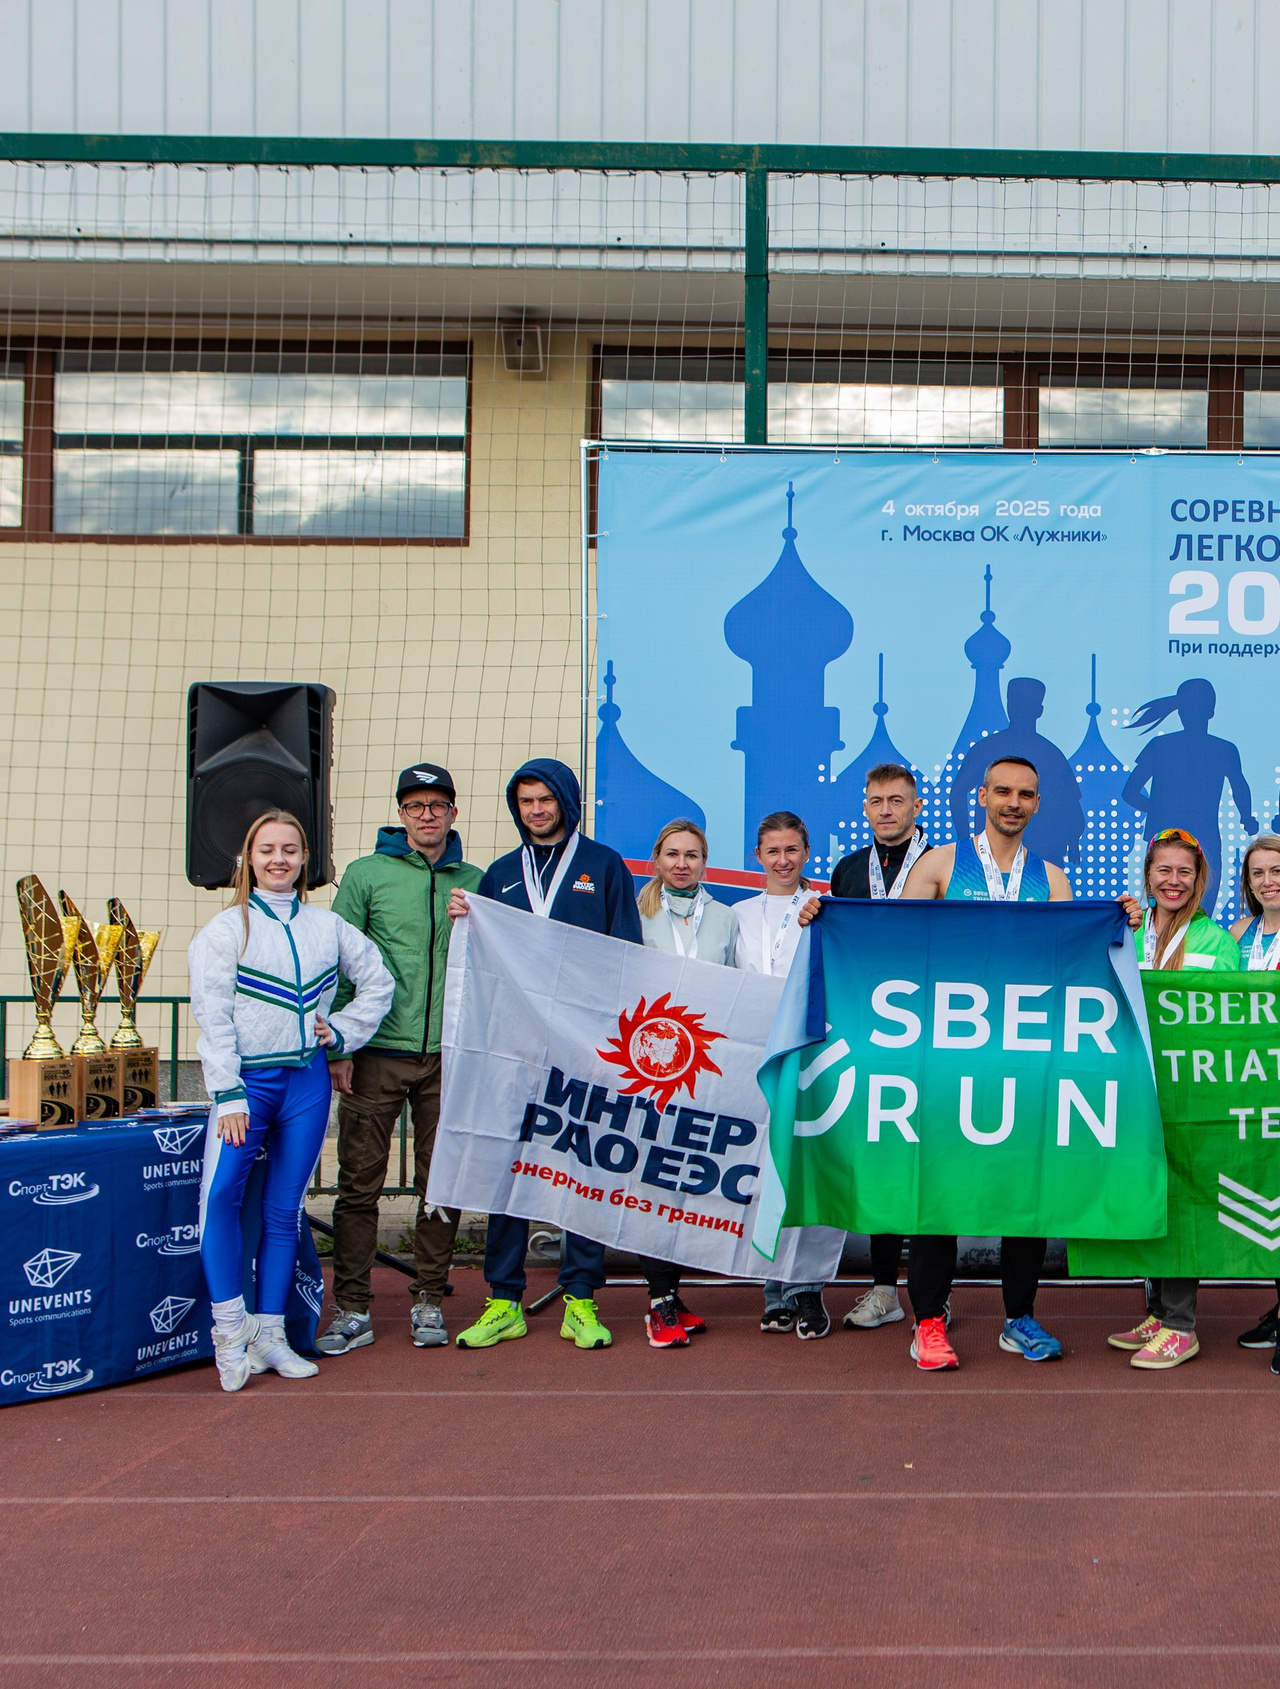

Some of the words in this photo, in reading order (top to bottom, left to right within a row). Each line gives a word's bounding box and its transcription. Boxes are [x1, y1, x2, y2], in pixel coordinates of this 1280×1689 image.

[881, 500, 895, 516] 4
[904, 501, 979, 520] октября
[995, 500, 1050, 517] 2025
[1059, 504, 1102, 519] года
[881, 529, 893, 542] г.
[903, 525, 975, 542] Москва
[980, 525, 1010, 542] ОК
[1168, 640, 1203, 657] При
[868, 979, 1119, 1054] SBER
[543, 1065, 758, 1156] ИНТЕР
[867, 1074, 1119, 1148] RUN
[518, 1102, 639, 1174] РАО
[640, 1144, 761, 1206] ЕЭС
[143, 1159, 205, 1179] UNEVEN
[143, 1181, 164, 1192] Sports
[164, 1176, 202, 1188] communica
[510, 1160, 604, 1202] энергия
[609, 1188, 652, 1213] без
[656, 1204, 745, 1239] границ
[9, 1289, 92, 1315] UNEVENTS
[9, 1316, 33, 1328] Sports
[34, 1307, 92, 1322] communications
[137, 1330, 199, 1361] UNEVENTS
